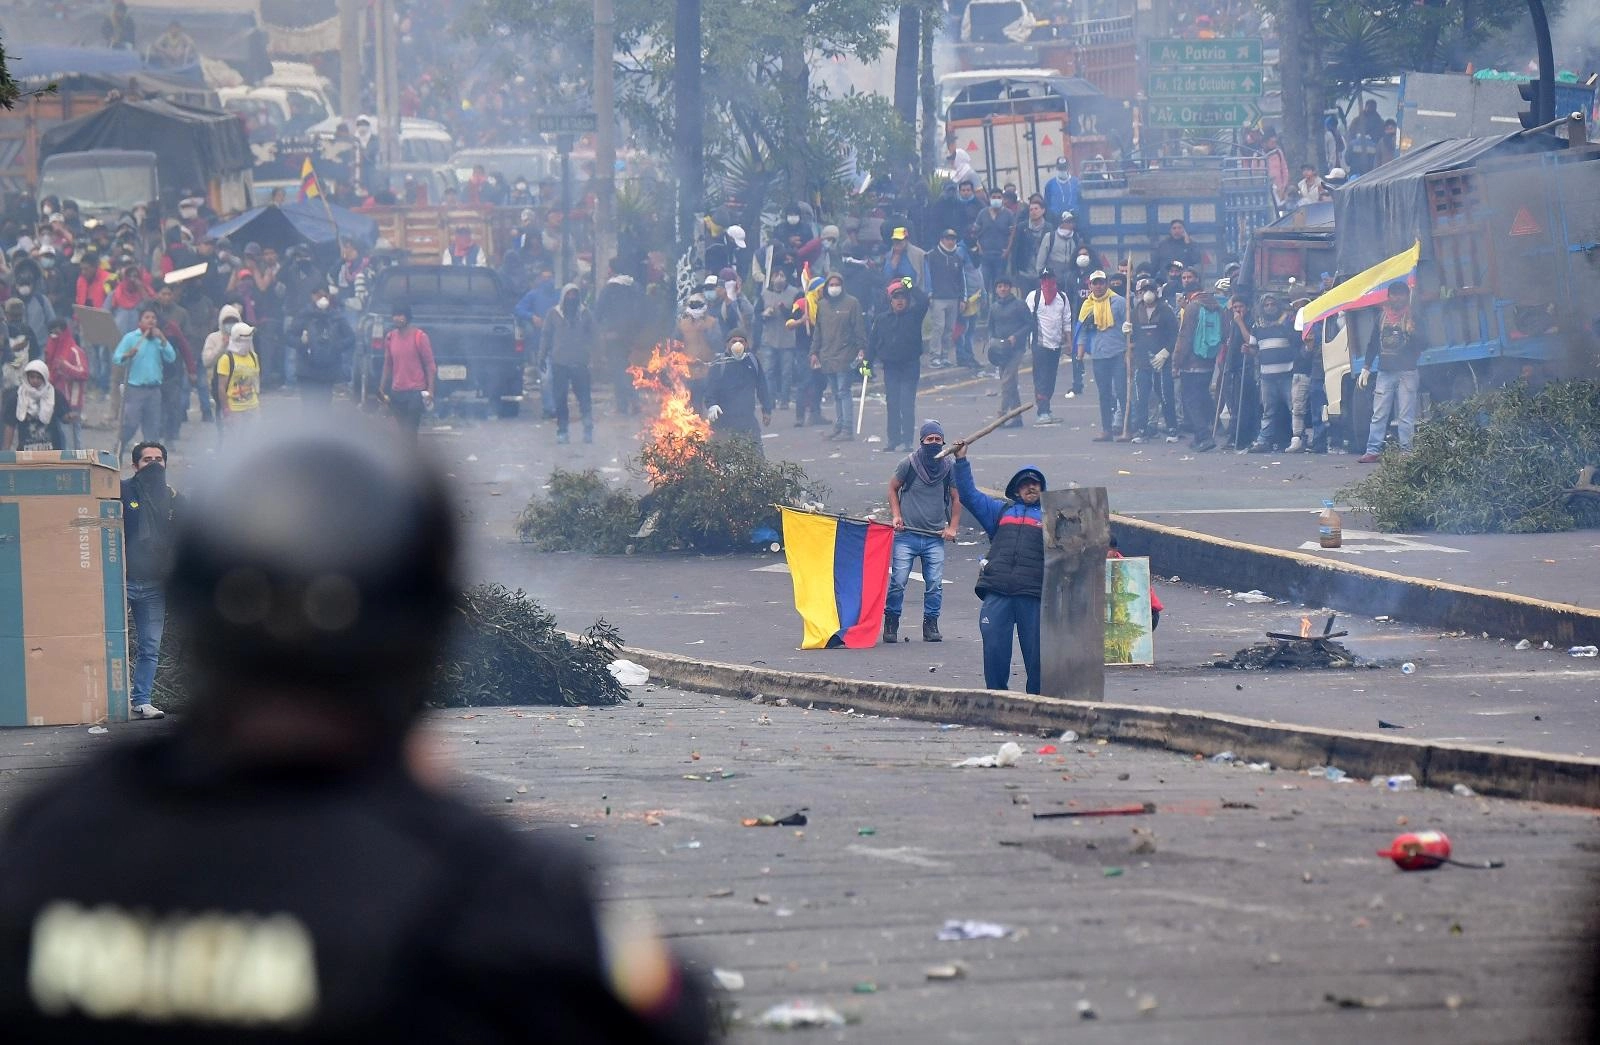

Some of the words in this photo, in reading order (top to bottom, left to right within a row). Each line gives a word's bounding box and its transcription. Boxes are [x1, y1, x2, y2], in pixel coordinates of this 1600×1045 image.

[1161, 45, 1180, 60] Av.
[1185, 45, 1226, 60] Patria
[1173, 76, 1183, 91] 12
[1185, 76, 1197, 91] de
[1200, 75, 1236, 91] Octubre
[107, 508, 117, 562] SSUNG
